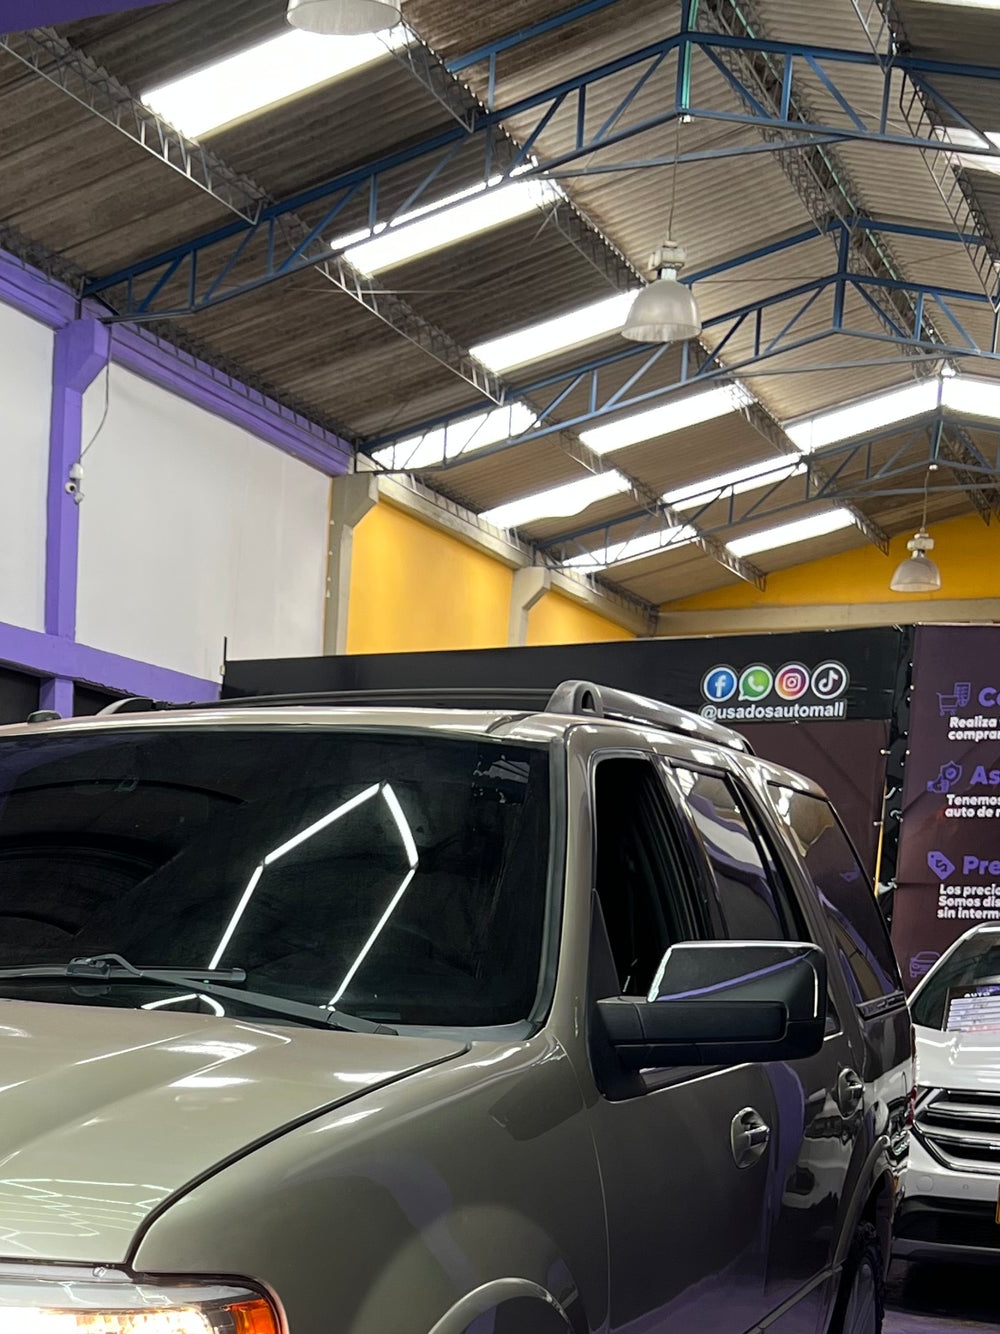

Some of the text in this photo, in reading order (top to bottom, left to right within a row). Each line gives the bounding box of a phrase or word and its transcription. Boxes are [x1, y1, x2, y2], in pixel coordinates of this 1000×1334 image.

[701, 702, 844, 720] @usadosautomall
[949, 715, 997, 729] Realiza
[944, 806, 976, 818] auto
[977, 806, 994, 818] de
[963, 855, 1000, 876] Pre
[939, 883, 962, 896] Los
[938, 896, 981, 908] Somos
[936, 906, 1000, 920] sin interm
